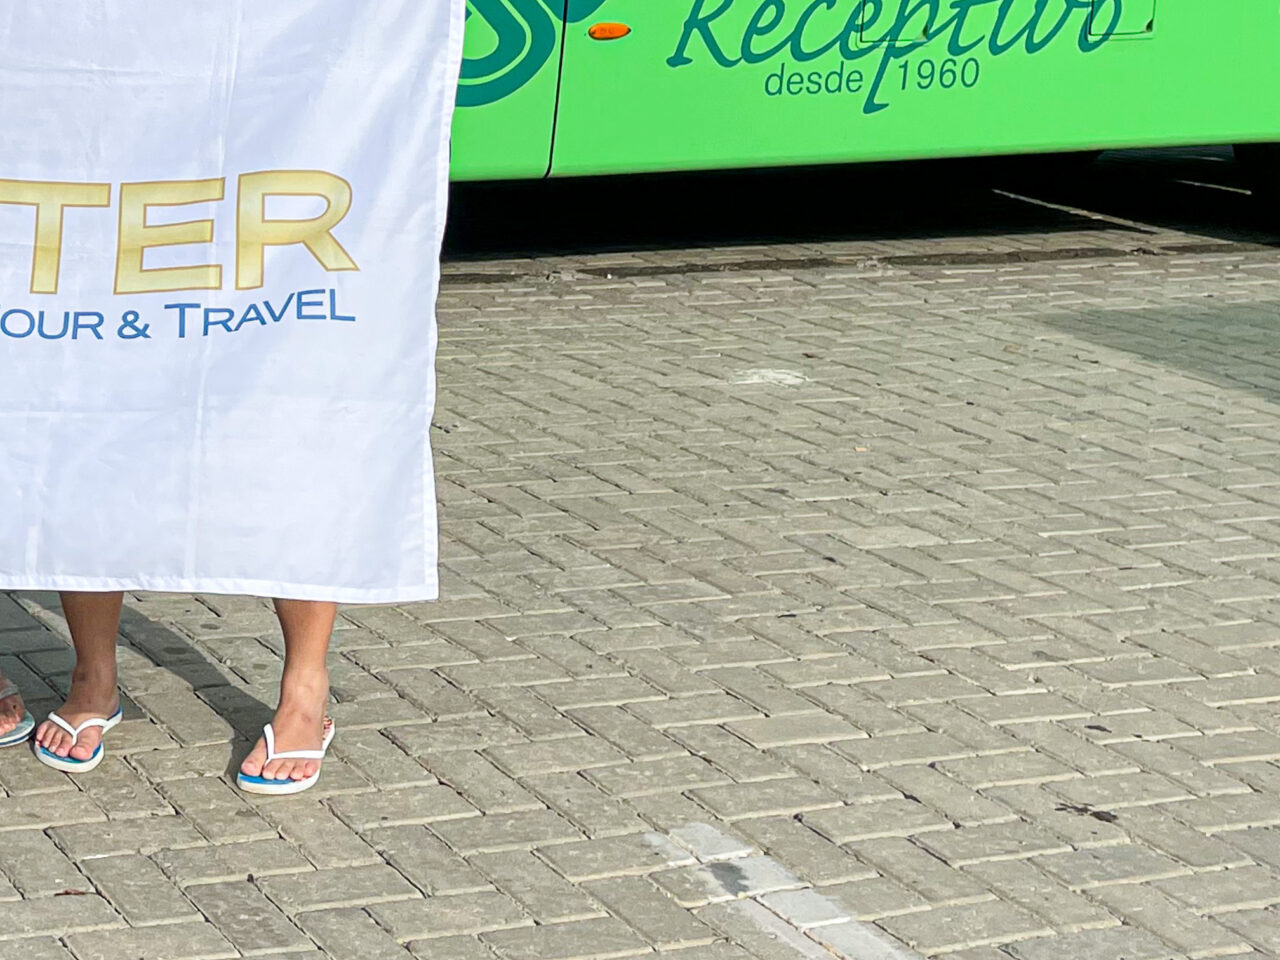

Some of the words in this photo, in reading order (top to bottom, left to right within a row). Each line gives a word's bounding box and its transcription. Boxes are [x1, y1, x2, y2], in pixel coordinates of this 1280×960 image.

[764, 62, 864, 96] desde
[897, 58, 981, 91] 1960
[117, 310, 151, 338] &
[164, 288, 356, 338] TRAVEL
